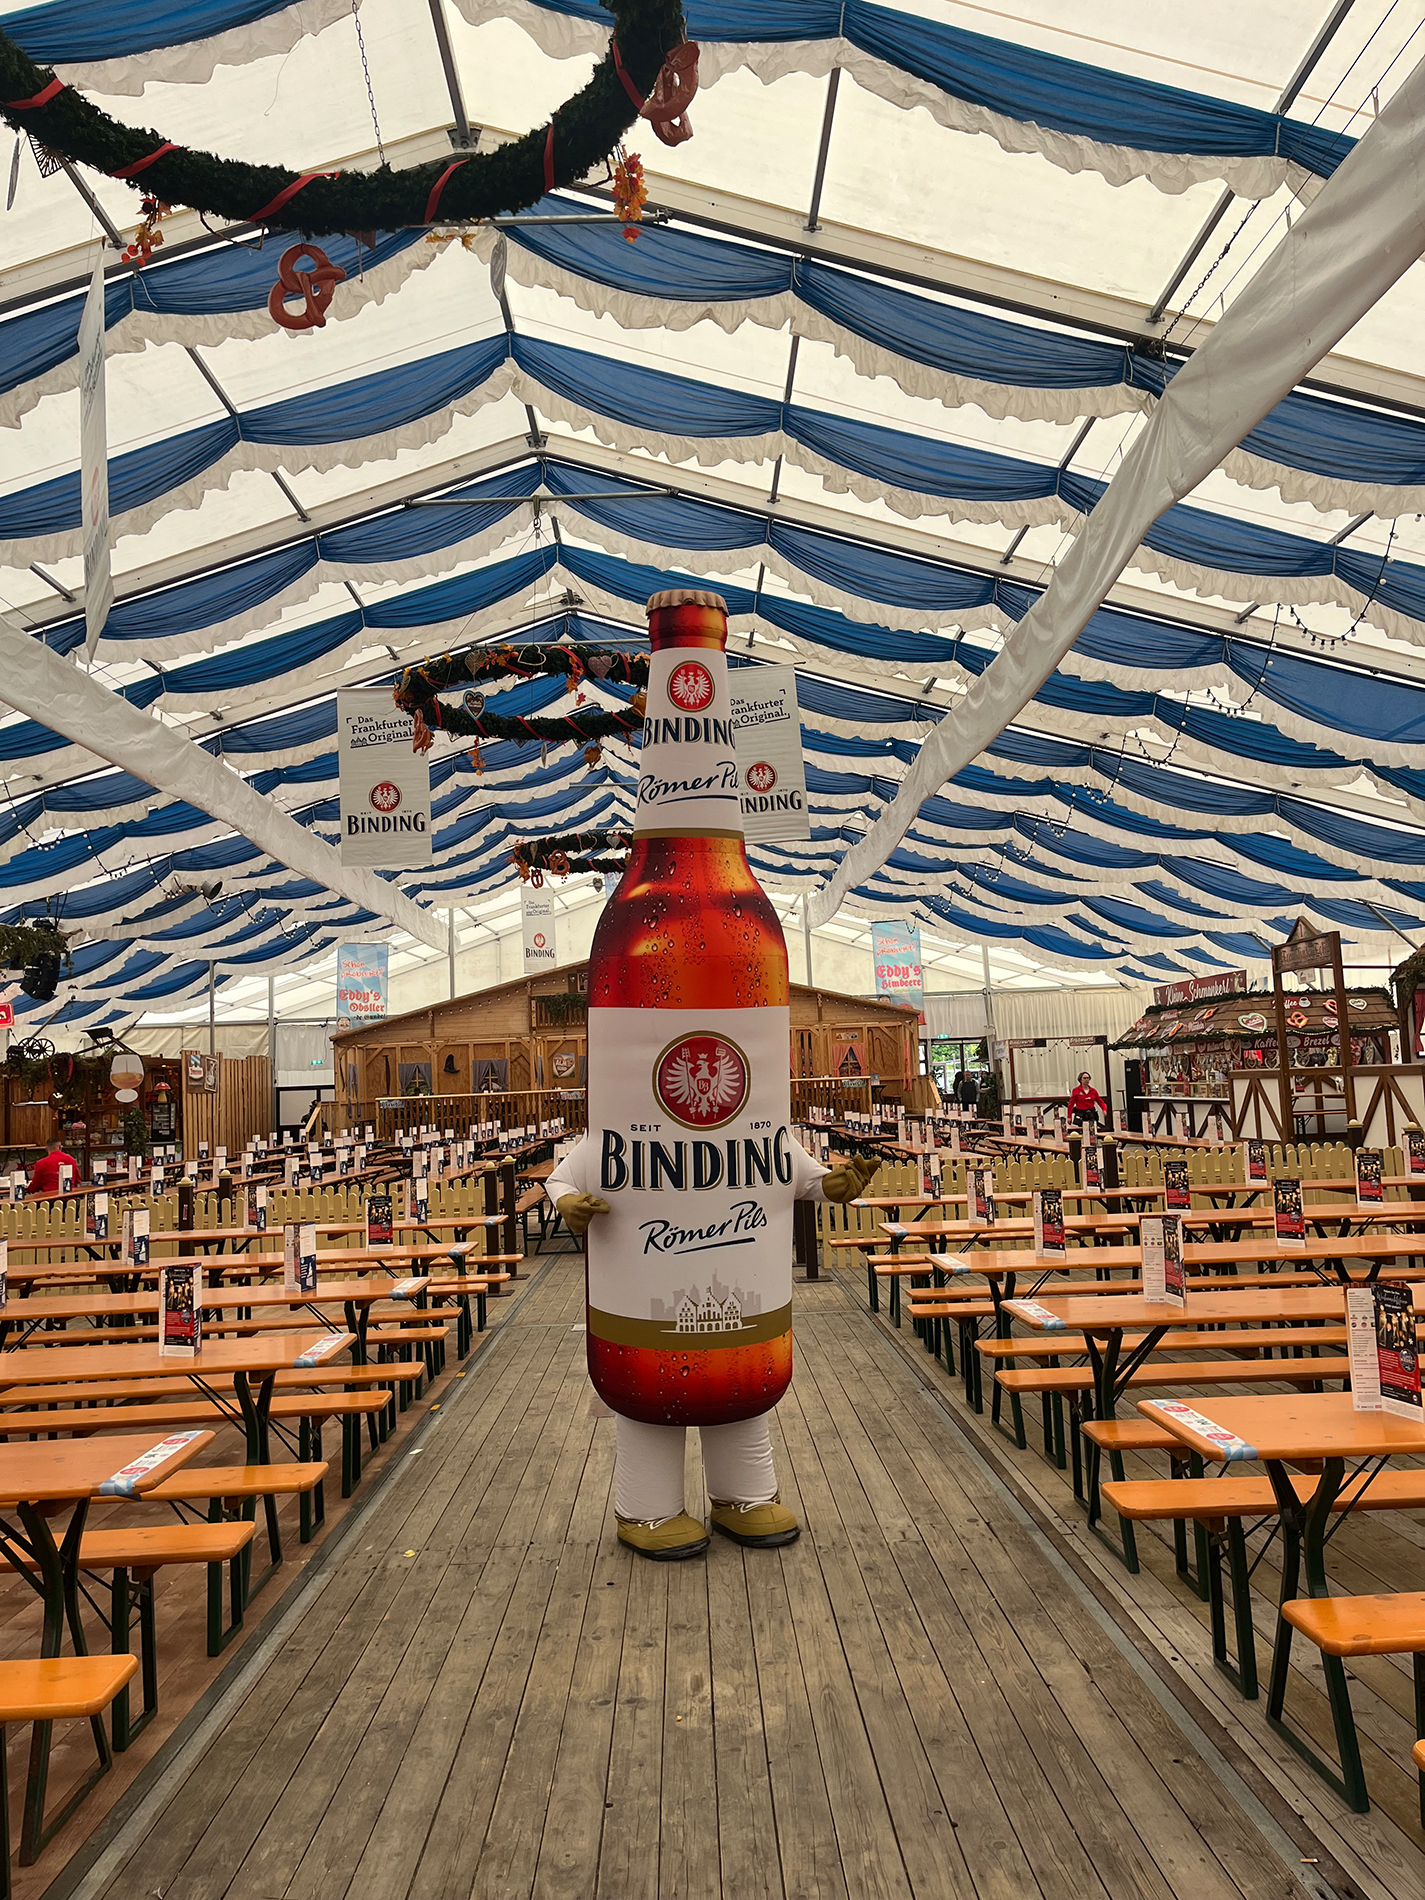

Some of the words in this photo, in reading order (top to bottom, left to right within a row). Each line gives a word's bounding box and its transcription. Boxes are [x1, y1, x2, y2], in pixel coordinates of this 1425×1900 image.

[731, 699, 784, 716] rankfurter
[740, 707, 787, 723] Original.
[351, 719, 414, 735] Frankfurter
[357, 716, 374, 724] Das
[637, 774, 719, 809] Römer
[716, 761, 740, 789] Pil
[740, 790, 802, 814] INDING
[347, 811, 426, 836] BINDING
[525, 947, 555, 959] BINDING
[881, 979, 922, 990] Himbeere
[338, 988, 381, 1003] Eddy's
[1303, 1035, 1331, 1047] Brezel
[630, 1124, 661, 1132] SEIT
[750, 1120, 771, 1130] 1870
[600, 1125, 793, 1192] BINDING
[638, 1219, 733, 1255] Römer
[730, 1200, 767, 1233] Pils
